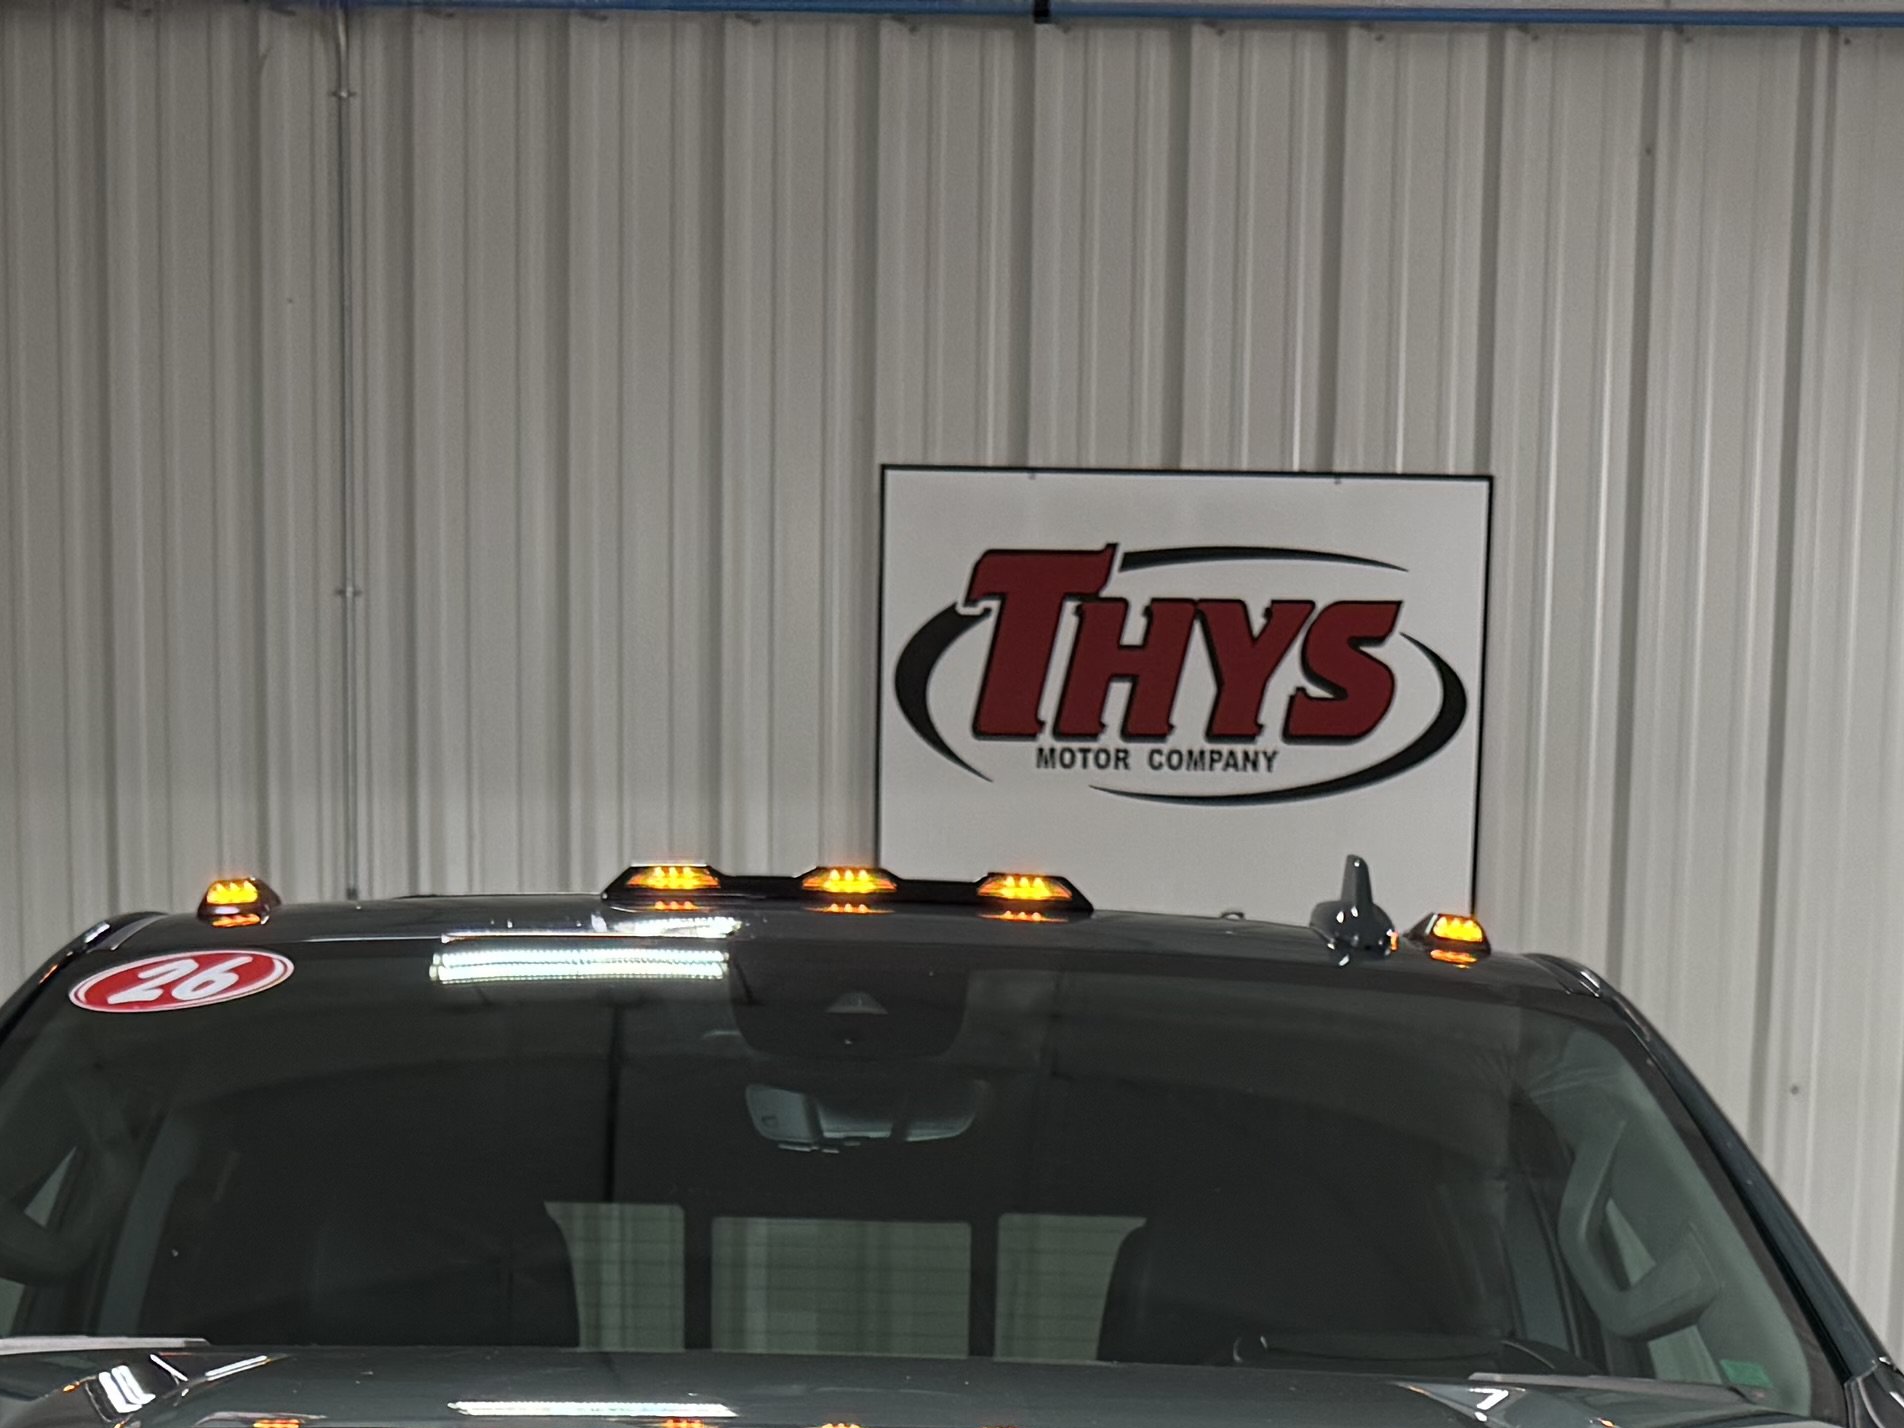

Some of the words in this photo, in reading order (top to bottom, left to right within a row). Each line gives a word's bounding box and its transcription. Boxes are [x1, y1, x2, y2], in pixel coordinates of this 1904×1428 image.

[964, 542, 1403, 745] THYS
[1036, 746, 1131, 772] MOTOR
[1147, 748, 1279, 774] COMPANY
[106, 955, 253, 1005] 26
